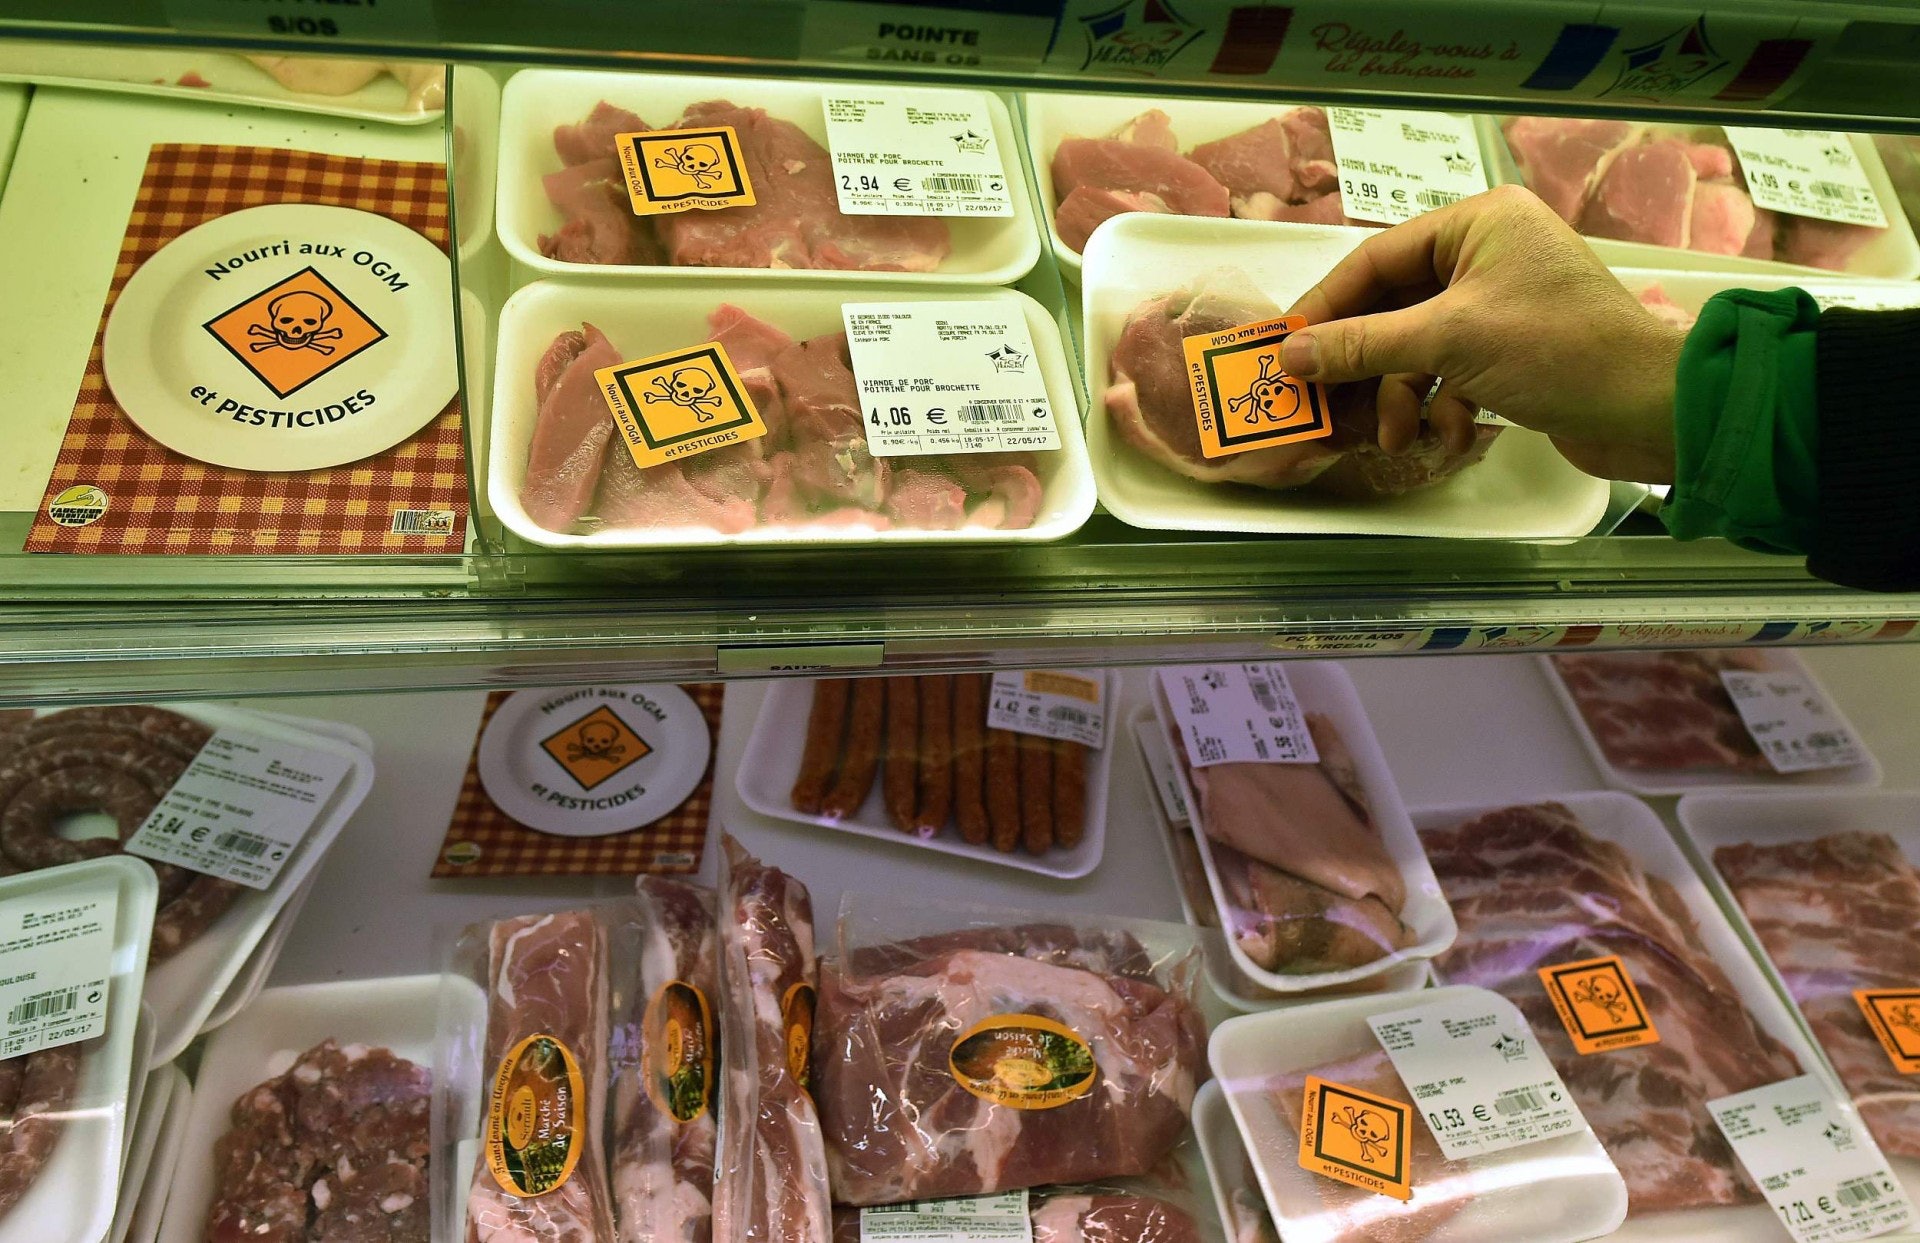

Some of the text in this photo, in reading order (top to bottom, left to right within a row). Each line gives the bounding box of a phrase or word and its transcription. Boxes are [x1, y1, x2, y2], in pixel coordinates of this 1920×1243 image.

[878, 22, 981, 46] POINTE
[1311, 22, 1521, 61] Régalez-vous à
[865, 47, 981, 67] SANS OS
[1325, 52, 1477, 80] la française
[622, 145, 644, 197] Nourri aux OGM
[841, 175, 913, 192] 2,94 €
[1344, 180, 1379, 199] 3,99
[1391, 189, 1408, 204] €
[673, 199, 729, 209] PESTICIDES
[965, 204, 1002, 212] 22/05/17
[205, 240, 410, 293] Nourri aux OGM
[1211, 321, 1288, 346] Nourri aux OGM
[862, 379, 894, 387] VIANDE
[913, 378, 935, 386] PORC
[935, 384, 981, 392] BROCHETTE
[190, 385, 376, 428] et PESTICIDES
[1191, 362, 1213, 431] et PESTICIDES
[605, 383, 643, 446] Nourri aux OGM
[870, 406, 948, 428] 4,06 €
[664, 431, 739, 457] et PESTICIDES
[1006, 436, 1047, 445] 22/05/17
[1285, 633, 1363, 643] POITRINE
[540, 687, 668, 723] Nourri aux OGM
[531, 782, 647, 812] et PESTICIDES
[190, 826, 212, 843] €
[48, 1024, 92, 1041] 22/05/17
[994, 1032, 1034, 1046] Saison
[493, 1101, 502, 1112] en
[551, 1086, 567, 1149] de Saison
[1428, 1104, 1493, 1132] 0,53 €
[538, 1099, 551, 1140] Marché
[489, 1115, 507, 1175] Transformé
[1304, 1127, 1315, 1148] OGM
[1323, 1164, 1386, 1190] et PESTICIDES
[1817, 1195, 1837, 1214] €
